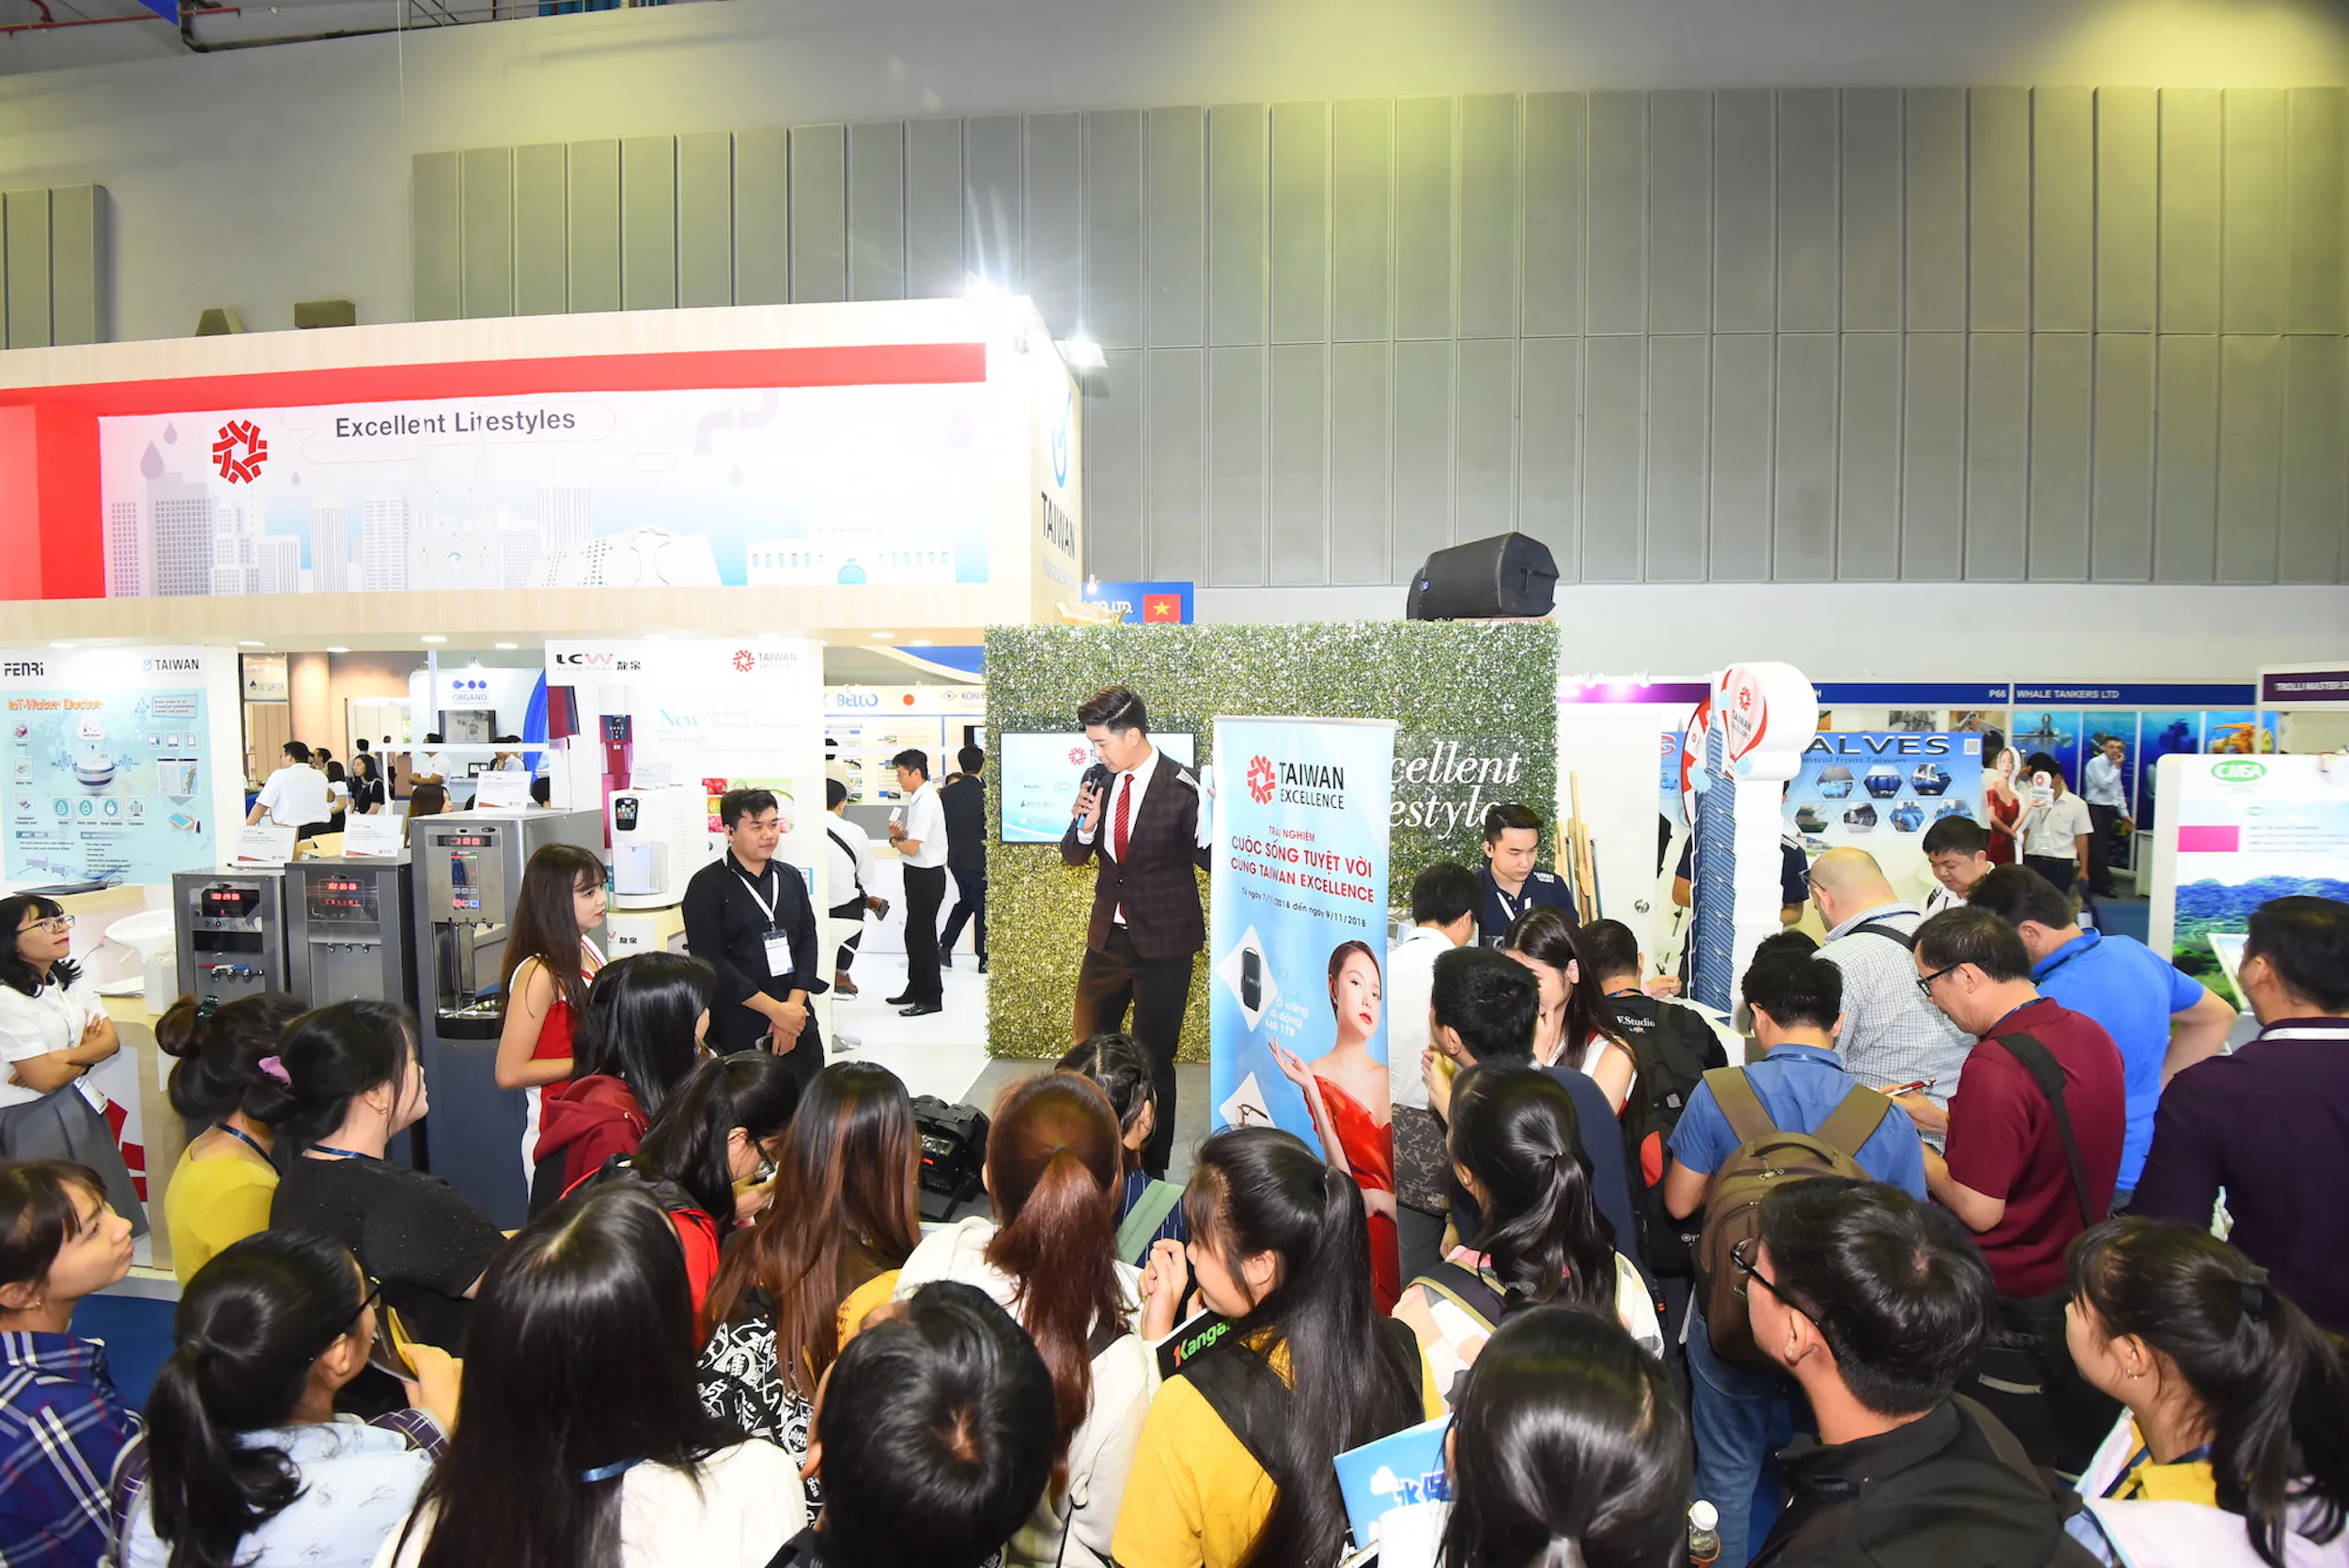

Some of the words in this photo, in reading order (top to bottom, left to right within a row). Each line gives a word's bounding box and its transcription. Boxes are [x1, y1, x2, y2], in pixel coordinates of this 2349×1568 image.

[336, 414, 445, 438] Excellent
[1041, 490, 1075, 560] TAIWAN
[155, 659, 199, 671] TAIWAN
[757, 653, 798, 662] TAIWAN
[1988, 690, 2007, 698] P66
[2016, 690, 2051, 698] WHALE
[2054, 690, 2099, 699] TANKERS
[2101, 690, 2120, 699] LTD
[659, 707, 698, 727] New
[1732, 709, 1751, 731] TAIWAN
[1802, 735, 1951, 755] ALVES
[1279, 762, 1344, 790] TAIWAN
[1281, 788, 1345, 810] EXCELLENCE
[1232, 835, 1262, 857] CUỘC
[1266, 839, 1299, 862] SỐNG
[1303, 850, 1340, 875] TUYỆT
[1346, 855, 1373, 877] VỜI
[1231, 856, 1256, 875] CÙNG
[1259, 863, 1296, 885] TAIWAN
[1300, 874, 1374, 903] EXCELLENCE
[1326, 910, 1366, 927] 9/11/2018
